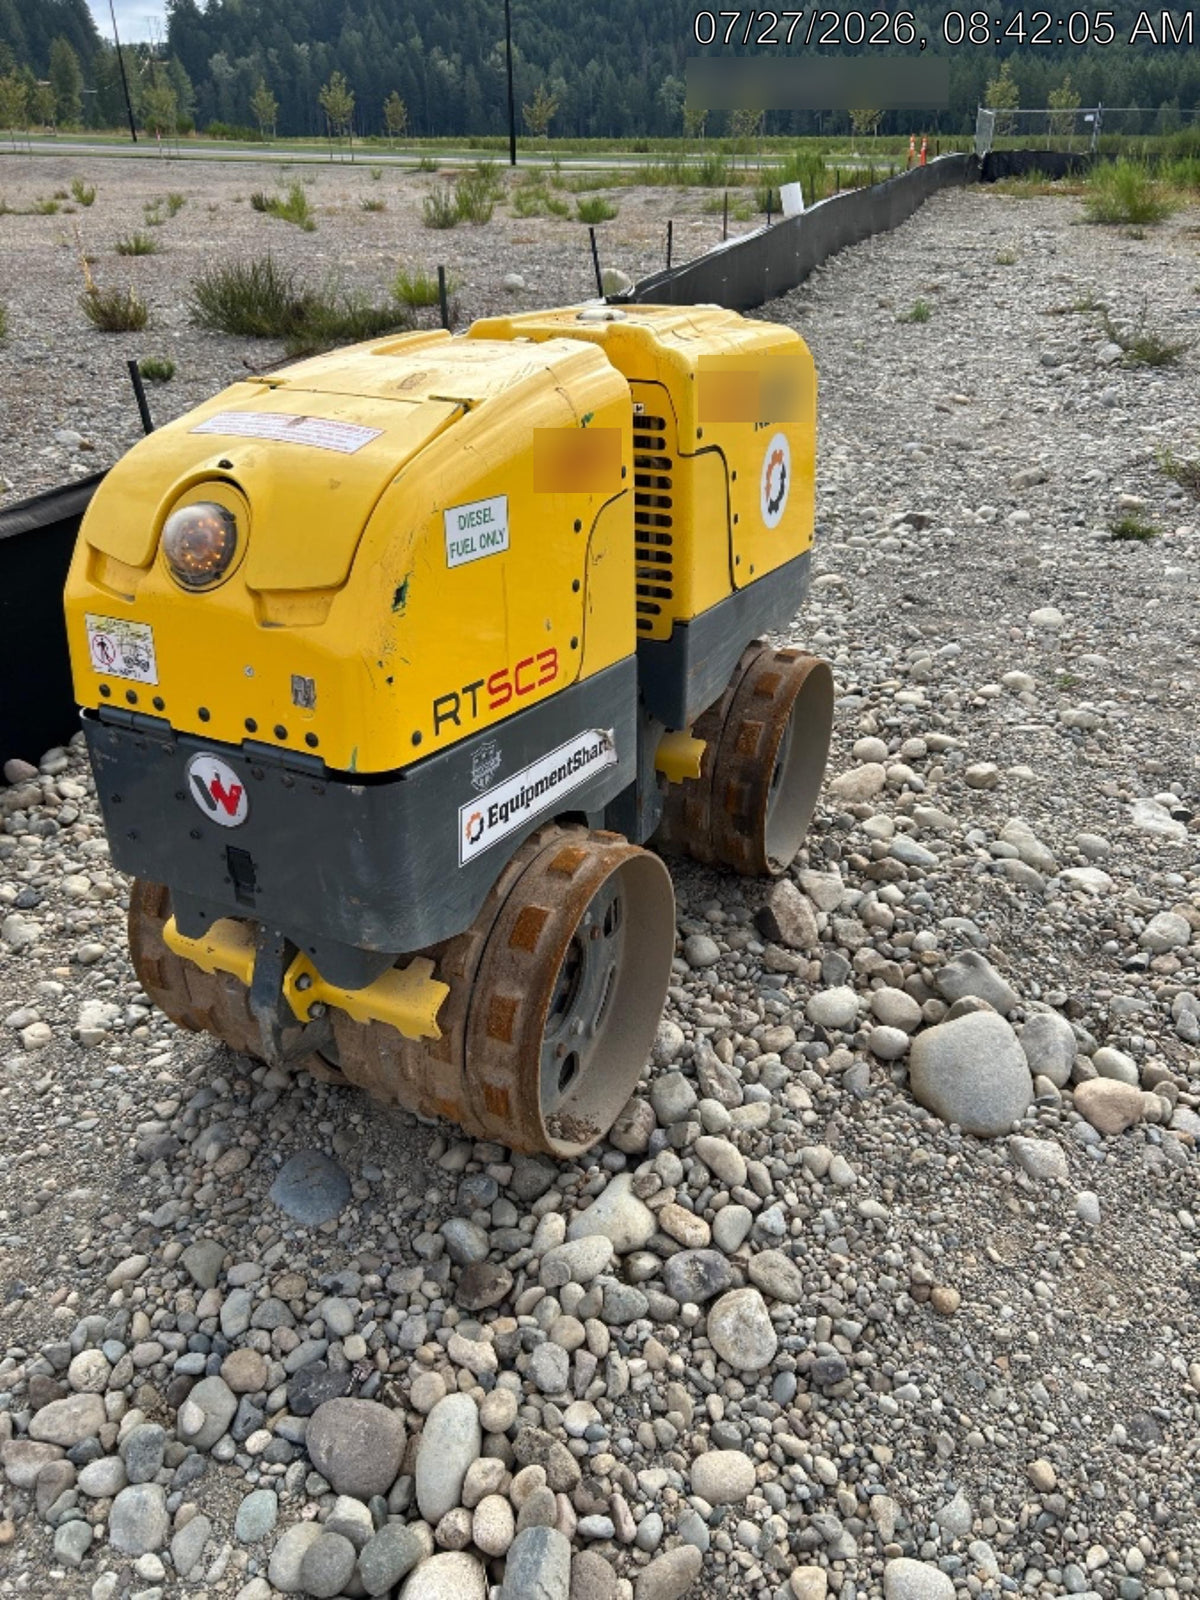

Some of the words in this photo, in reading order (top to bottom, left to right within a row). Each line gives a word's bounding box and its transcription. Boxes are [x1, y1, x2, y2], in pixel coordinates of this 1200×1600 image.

[457, 506, 496, 531] DIESEL
[449, 536, 477, 559] FUEL
[479, 527, 506, 550] ONLY
[433, 646, 559, 737] RTSC3
